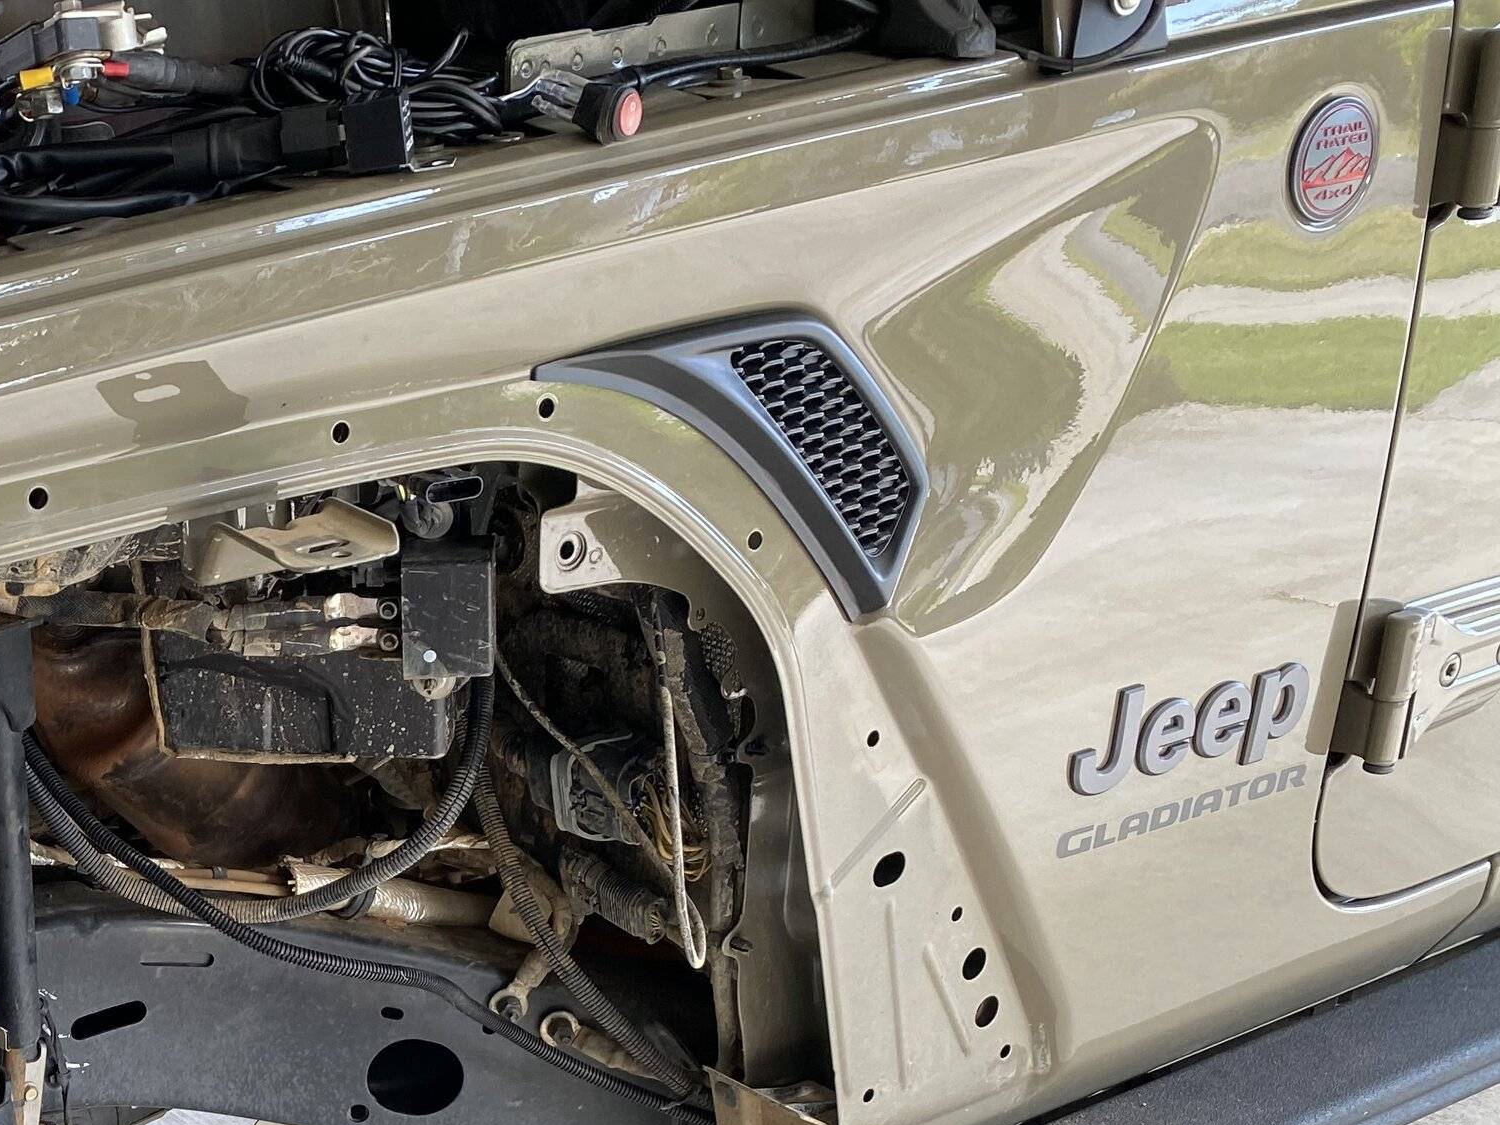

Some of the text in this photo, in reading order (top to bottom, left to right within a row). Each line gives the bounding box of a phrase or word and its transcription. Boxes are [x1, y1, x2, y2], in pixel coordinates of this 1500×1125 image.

[1321, 121, 1365, 137] TRAIL
[1315, 132, 1368, 151] RATED
[1314, 184, 1353, 201] 4x4
[1066, 661, 1310, 796] Jeep
[1056, 763, 1308, 859] GLADIATOR
